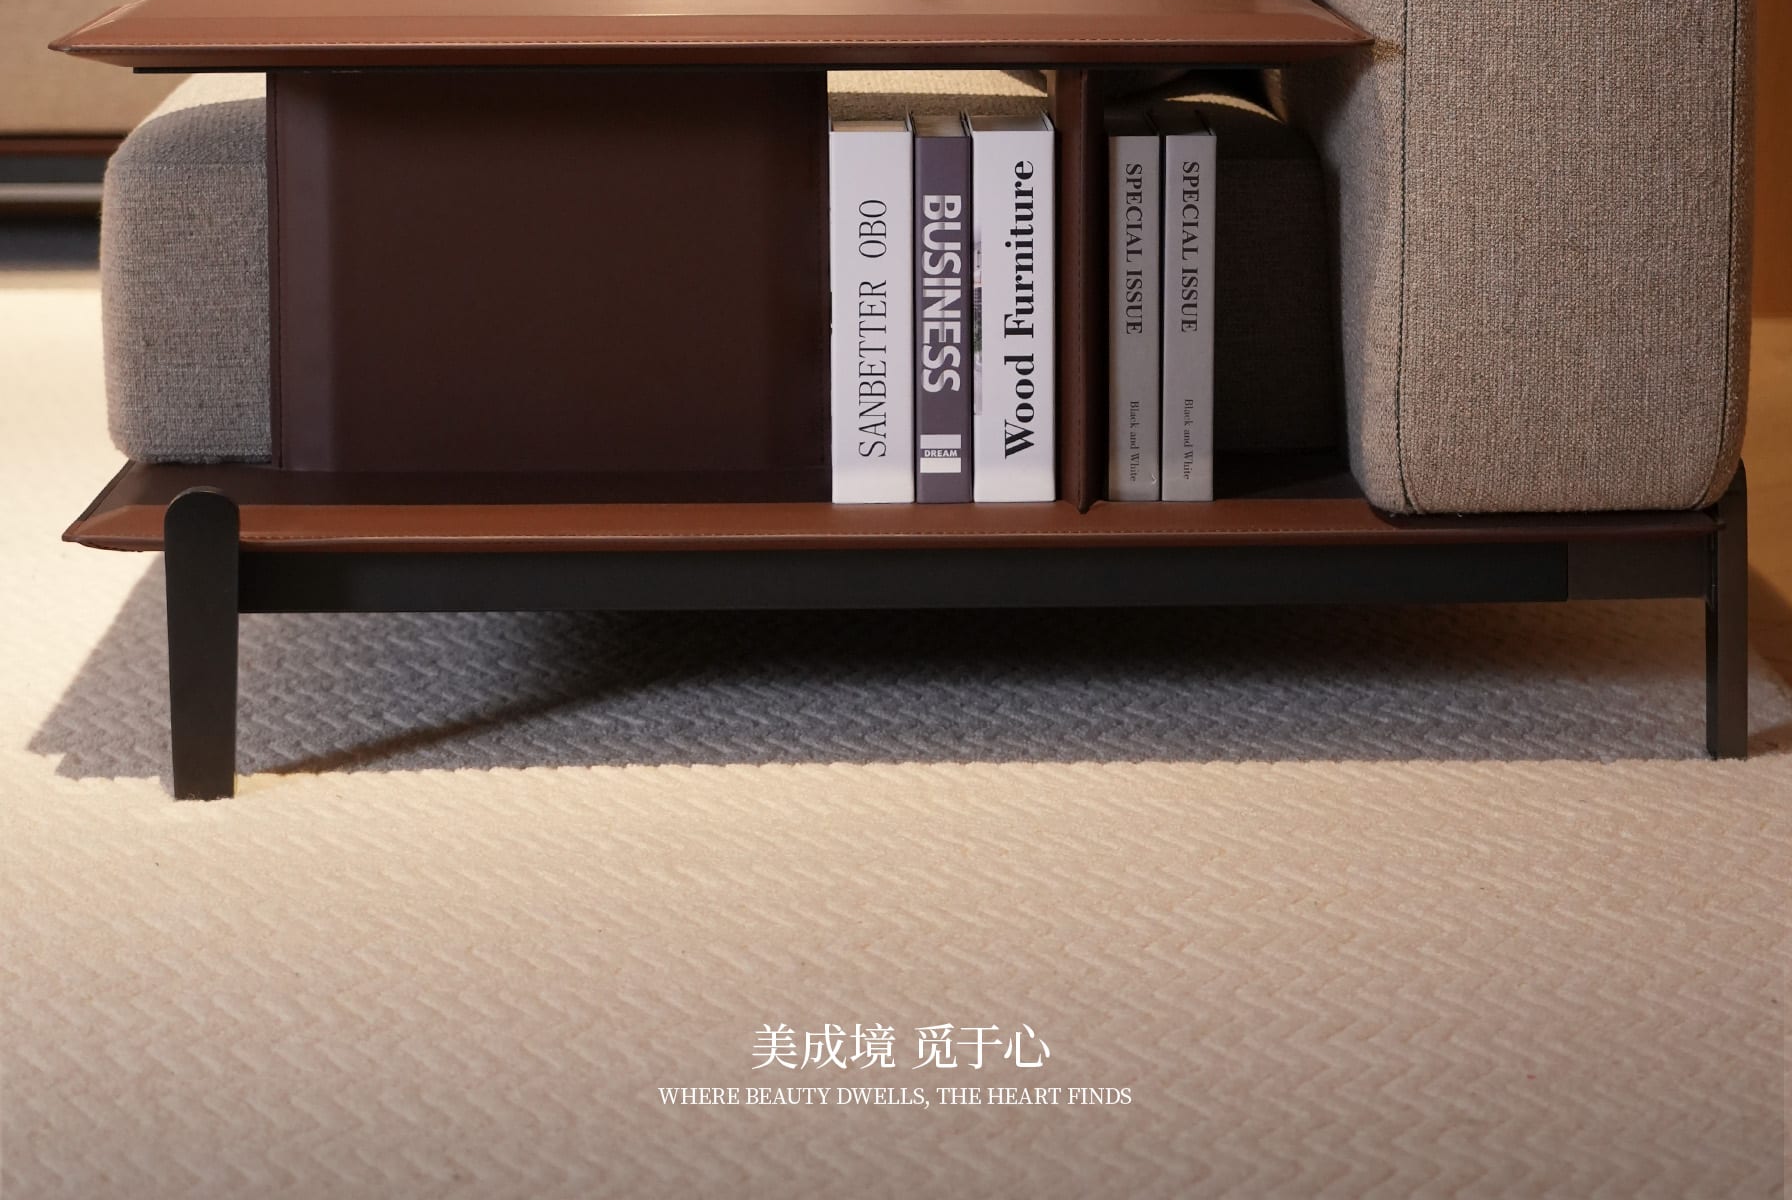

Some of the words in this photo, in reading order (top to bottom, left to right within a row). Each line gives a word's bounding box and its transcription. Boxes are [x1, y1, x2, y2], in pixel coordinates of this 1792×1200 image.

[858, 199, 888, 259] OBO
[1125, 162, 1143, 263] SPECIAL
[1182, 160, 1200, 260] SPECIAL
[1004, 160, 1035, 339] Furniture
[922, 194, 962, 393] BUSINESS
[1125, 269, 1143, 335] ISSUE
[1180, 266, 1198, 333] ISSUE
[858, 279, 888, 458] SANBETTER
[1004, 353, 1035, 459] Wood
[1129, 401, 1140, 429] Black
[1183, 399, 1194, 427] Black
[924, 449, 958, 457] DREAM
[1129, 431, 1140, 450] and
[1129, 453, 1140, 482] White
[1183, 429, 1194, 448] and
[1183, 450, 1194, 480] White
